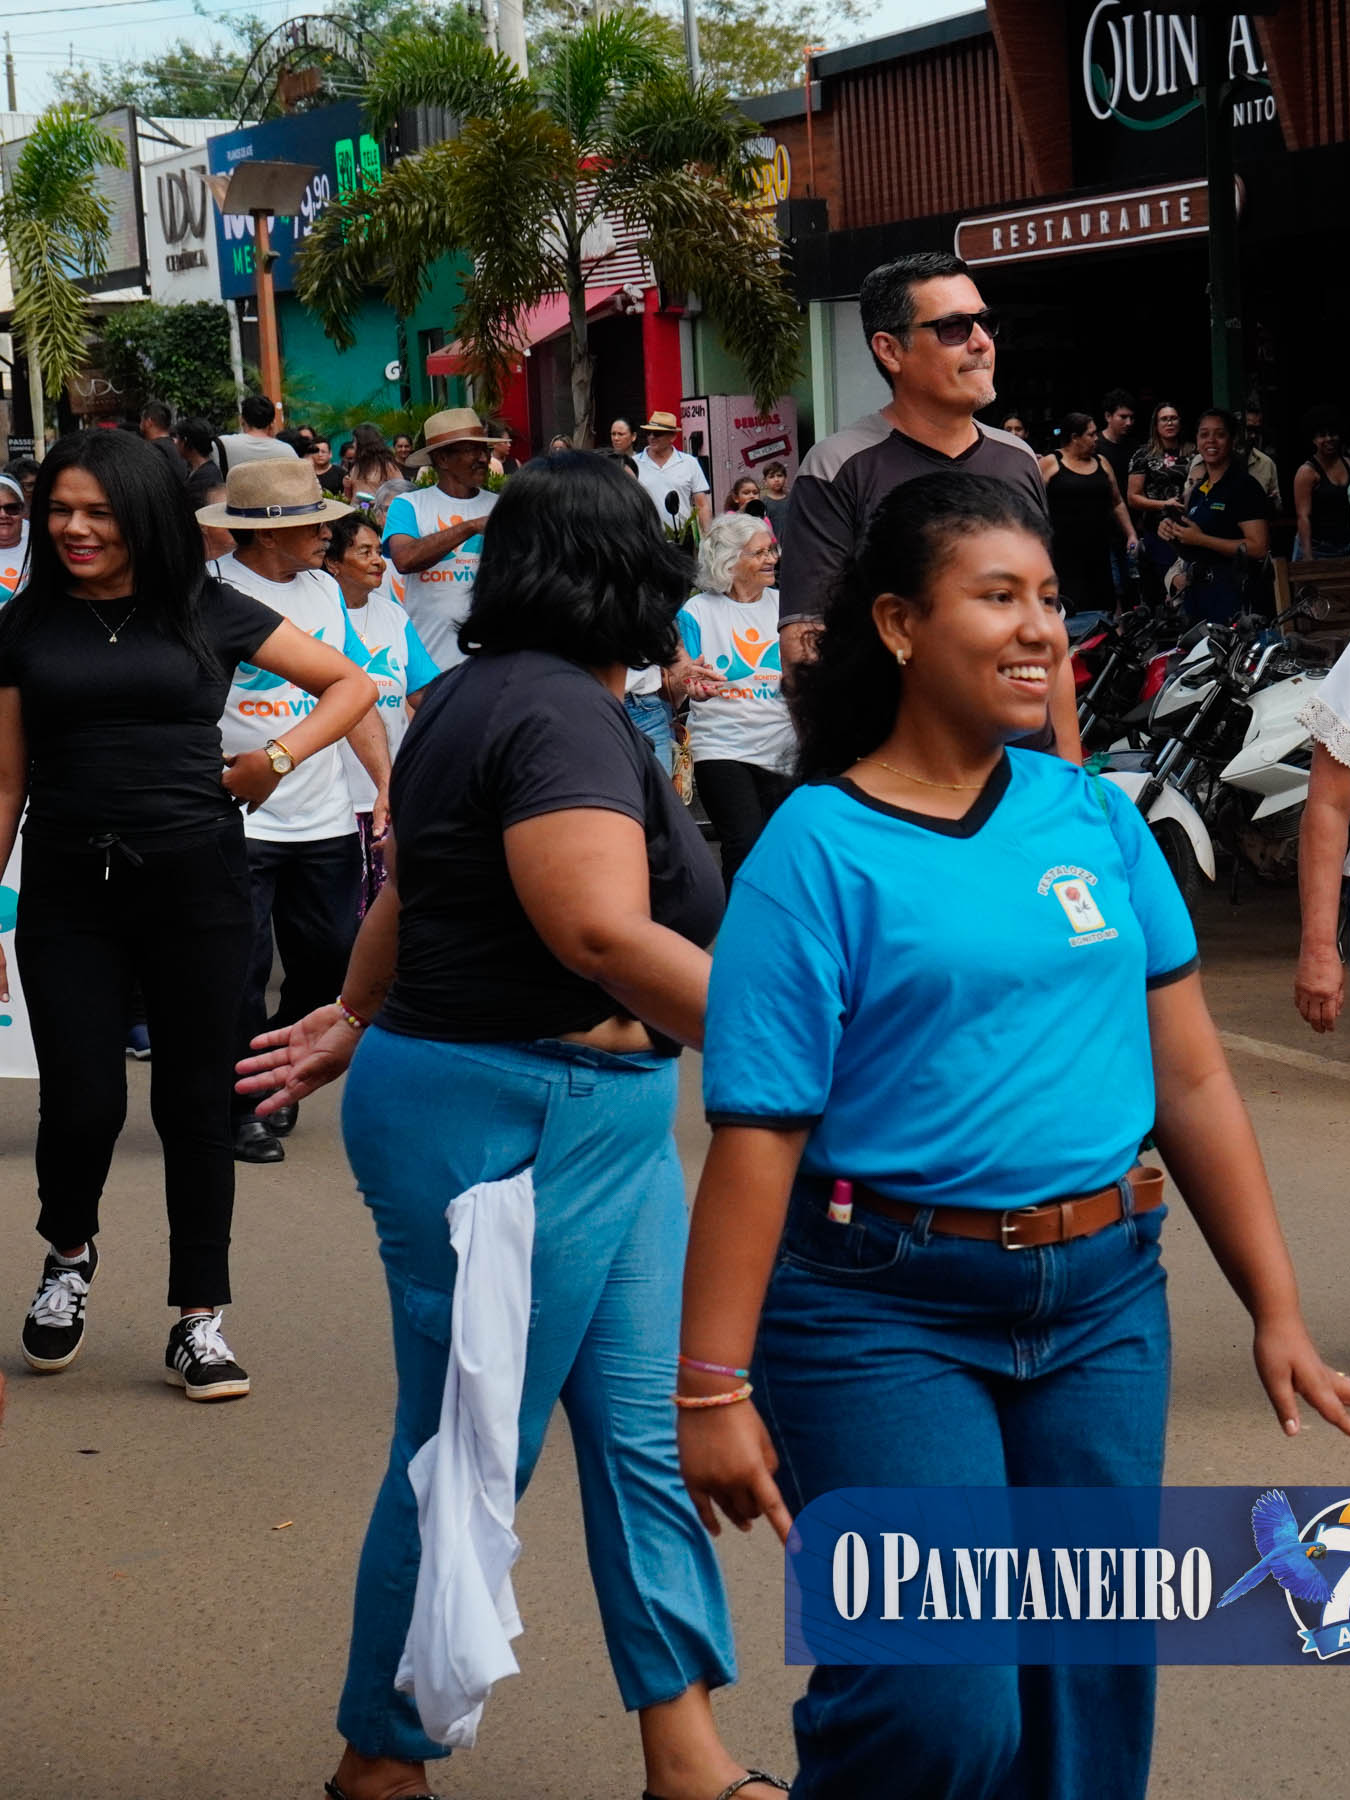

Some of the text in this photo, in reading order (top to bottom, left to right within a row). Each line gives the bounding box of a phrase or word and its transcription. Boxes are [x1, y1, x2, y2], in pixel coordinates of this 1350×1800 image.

[1083, 0, 1267, 119] QUINA
[1233, 96, 1275, 127] NITO
[992, 197, 1191, 250] RESTAURANTE
[420, 565, 478, 583] convi
[238, 691, 319, 717] convi
[720, 682, 780, 700] conviv
[1037, 865, 1098, 896] PESTALOZZI
